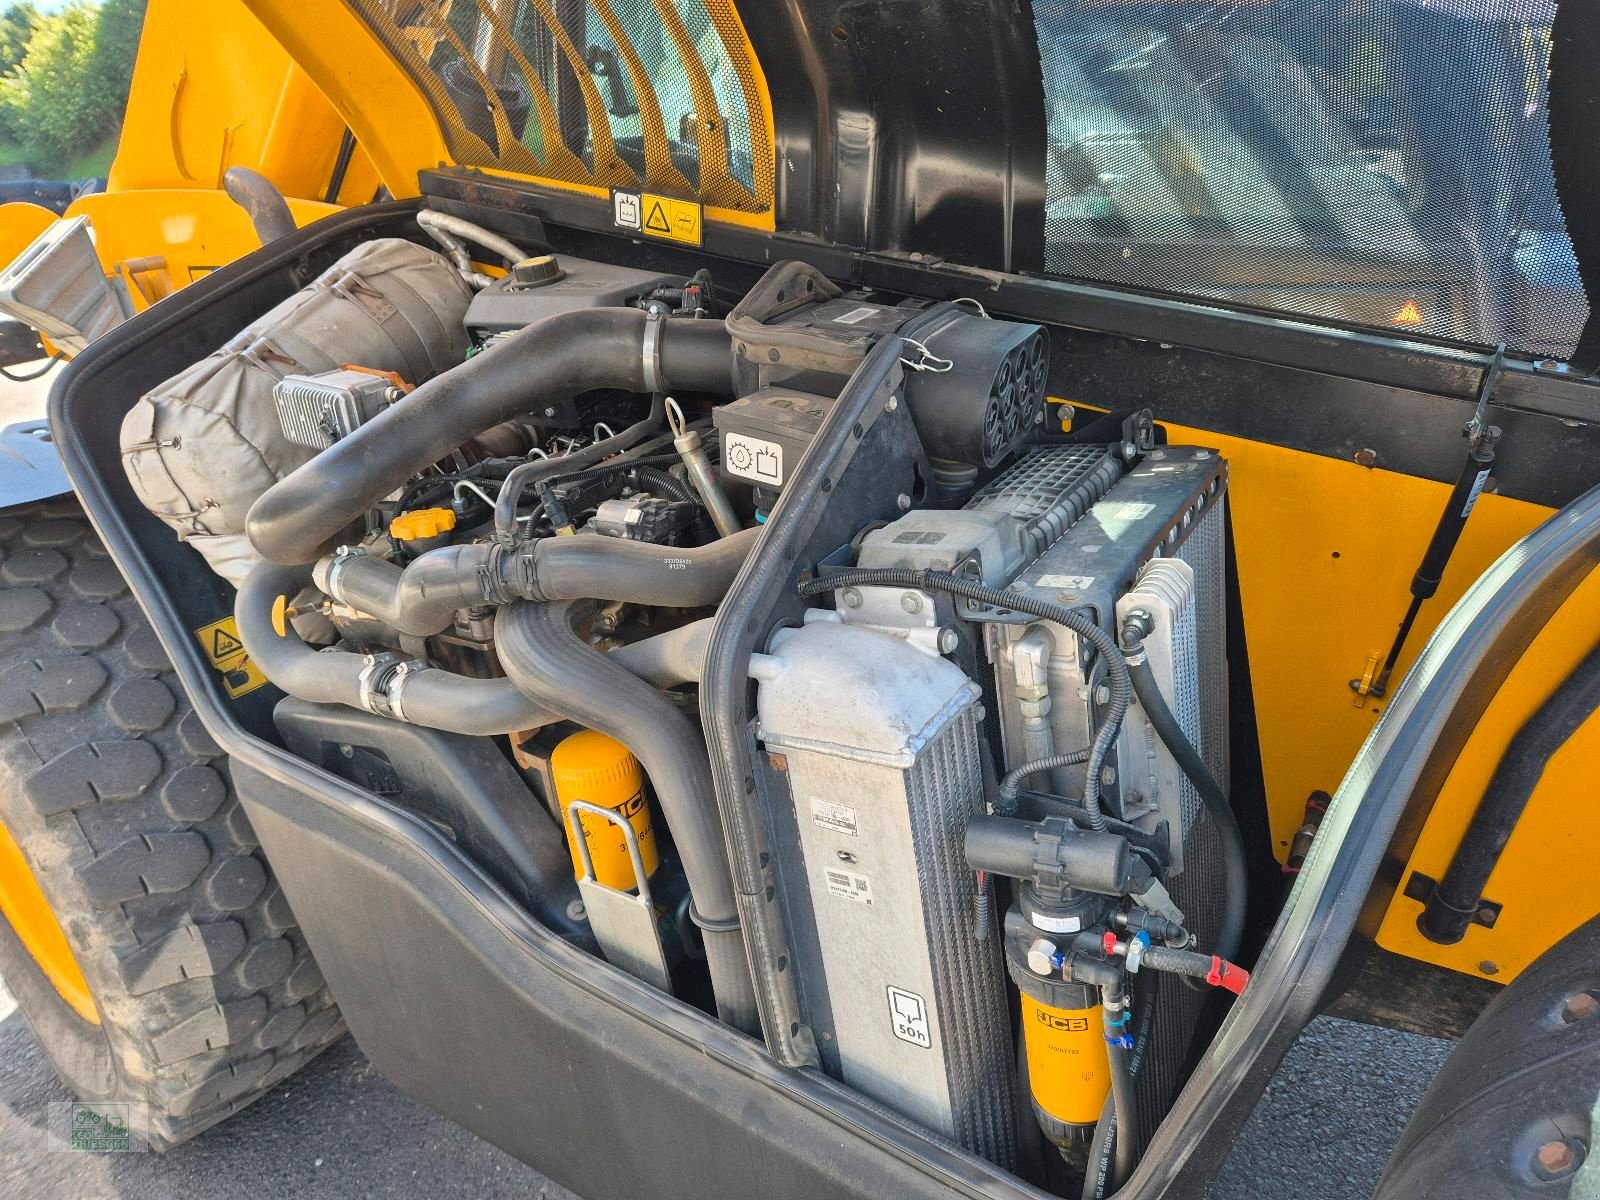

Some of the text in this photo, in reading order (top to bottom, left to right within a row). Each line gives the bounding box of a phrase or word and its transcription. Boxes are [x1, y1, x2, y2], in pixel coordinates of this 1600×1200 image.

[1036, 1008, 1089, 1032] JCB
[1100, 1157, 1109, 1171] WP
[1097, 1171, 1106, 1186] 200
[1095, 1186, 1104, 1199] PSI
